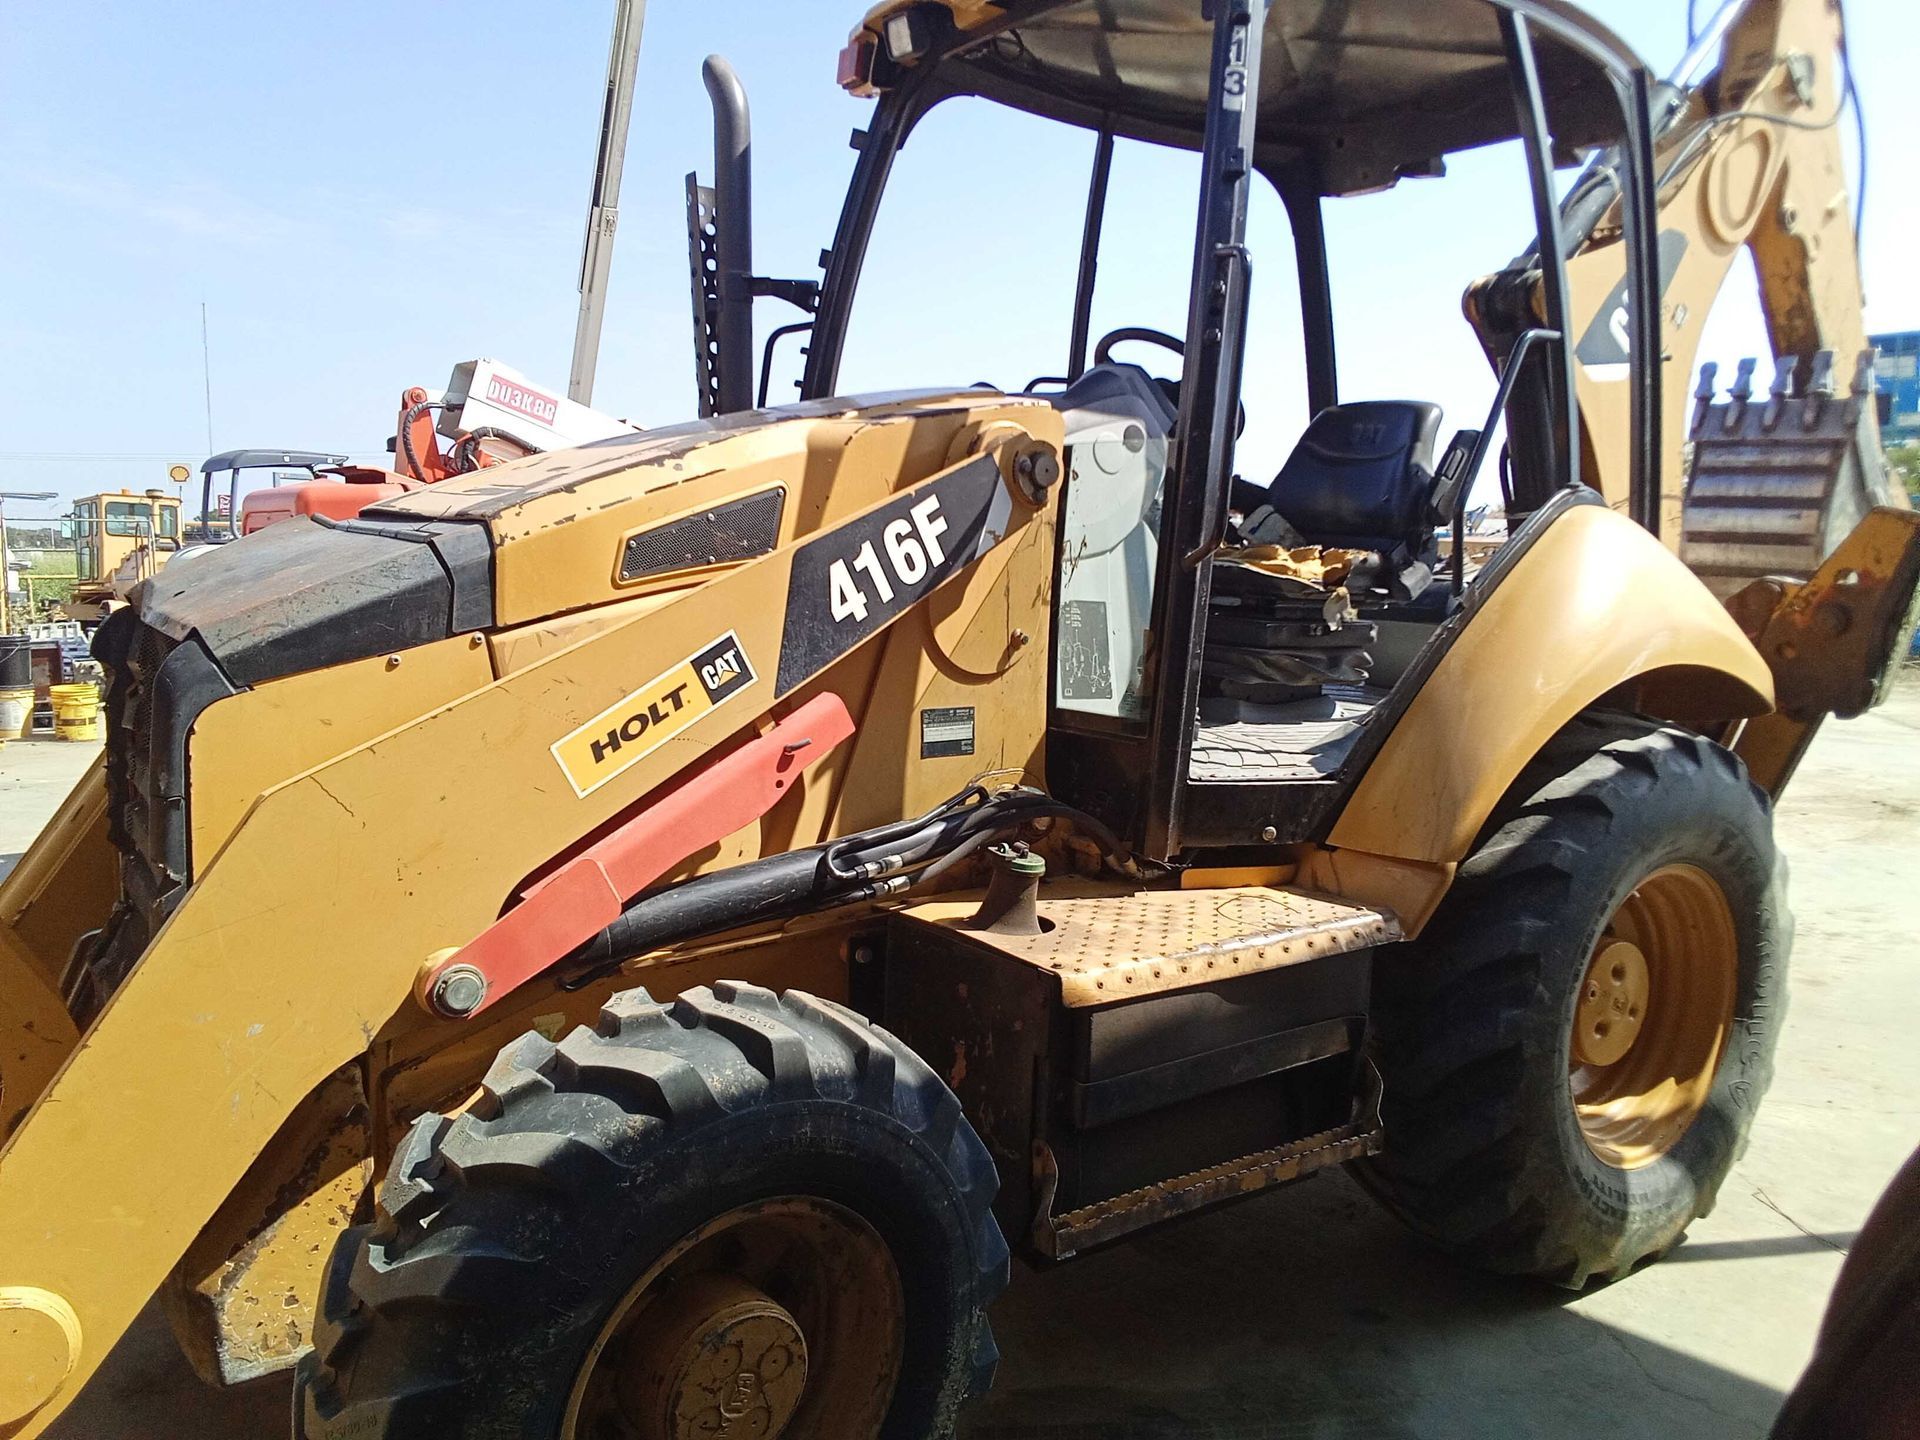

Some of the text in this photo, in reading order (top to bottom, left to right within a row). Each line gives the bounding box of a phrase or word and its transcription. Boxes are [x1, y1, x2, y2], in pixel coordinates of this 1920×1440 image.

[829, 493, 949, 623] 416F
[589, 648, 742, 765] HOLT CAT
